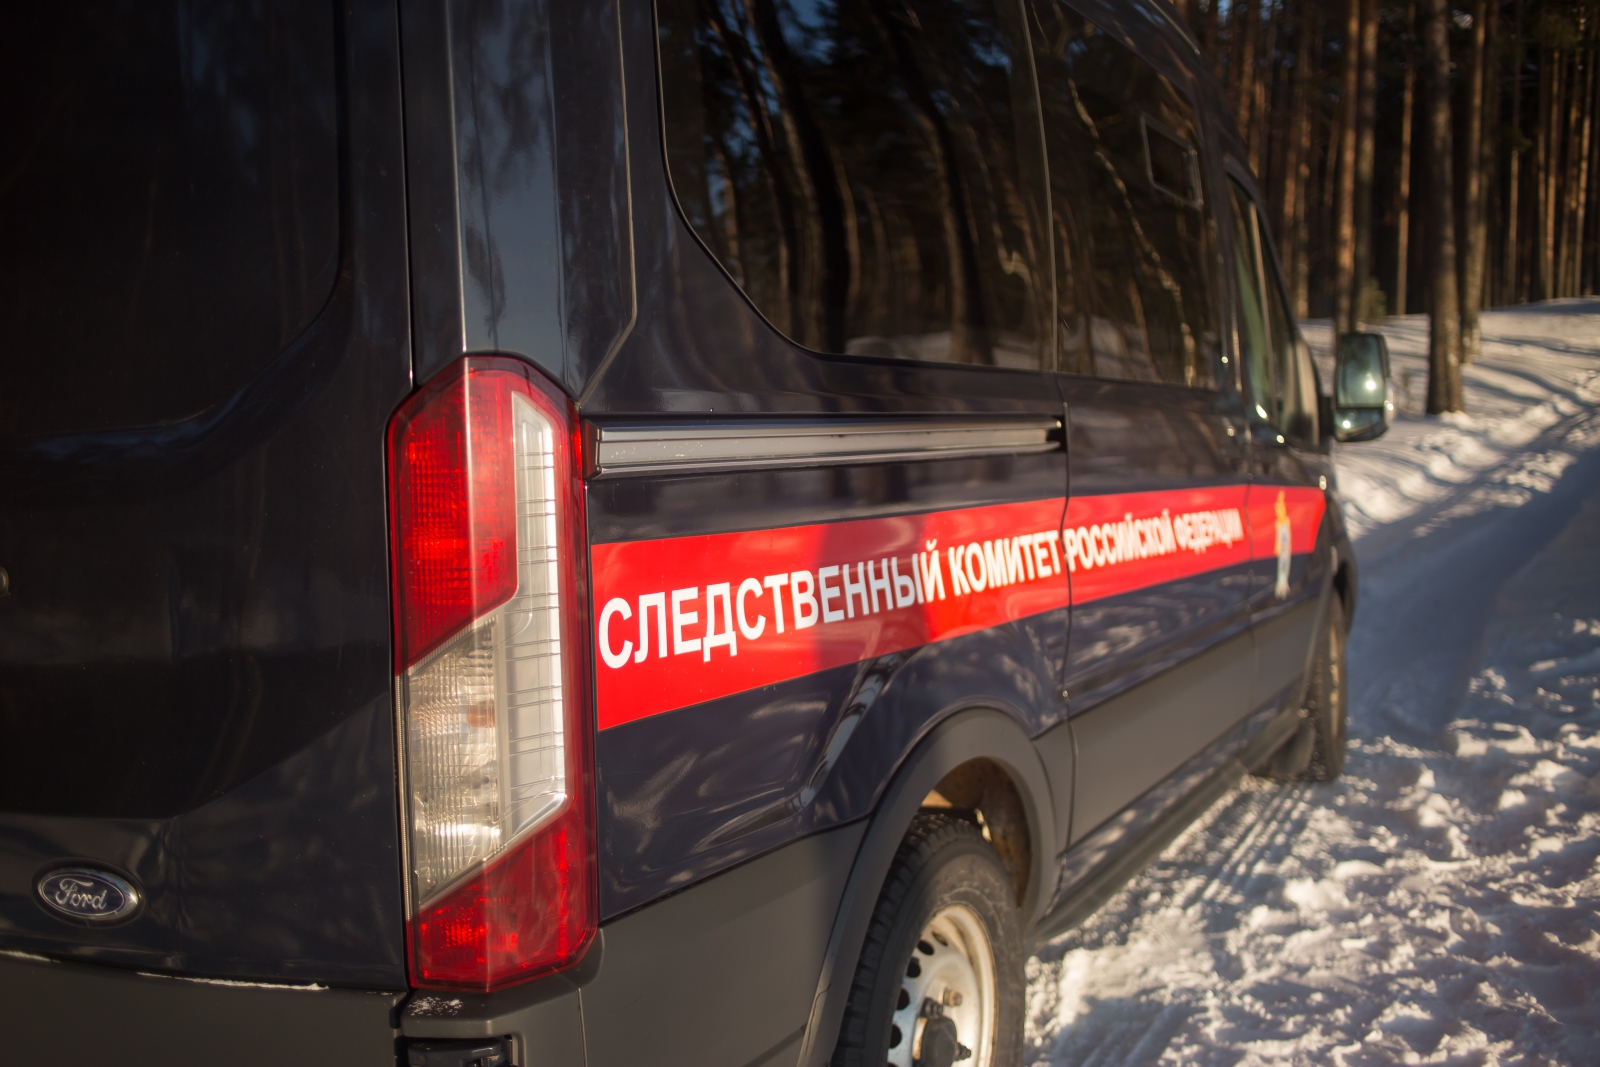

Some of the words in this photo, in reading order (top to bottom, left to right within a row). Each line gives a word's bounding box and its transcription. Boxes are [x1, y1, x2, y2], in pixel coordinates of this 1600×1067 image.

[598, 539, 946, 669] СЛЕДСТВЕННЫЙ
[947, 530, 1061, 601] КОМИТЕТ
[1063, 510, 1177, 572] РОССИЙСКОЙ
[1175, 508, 1245, 554] ФЕДЕРАЦИИ
[55, 878, 108, 910] Ford
